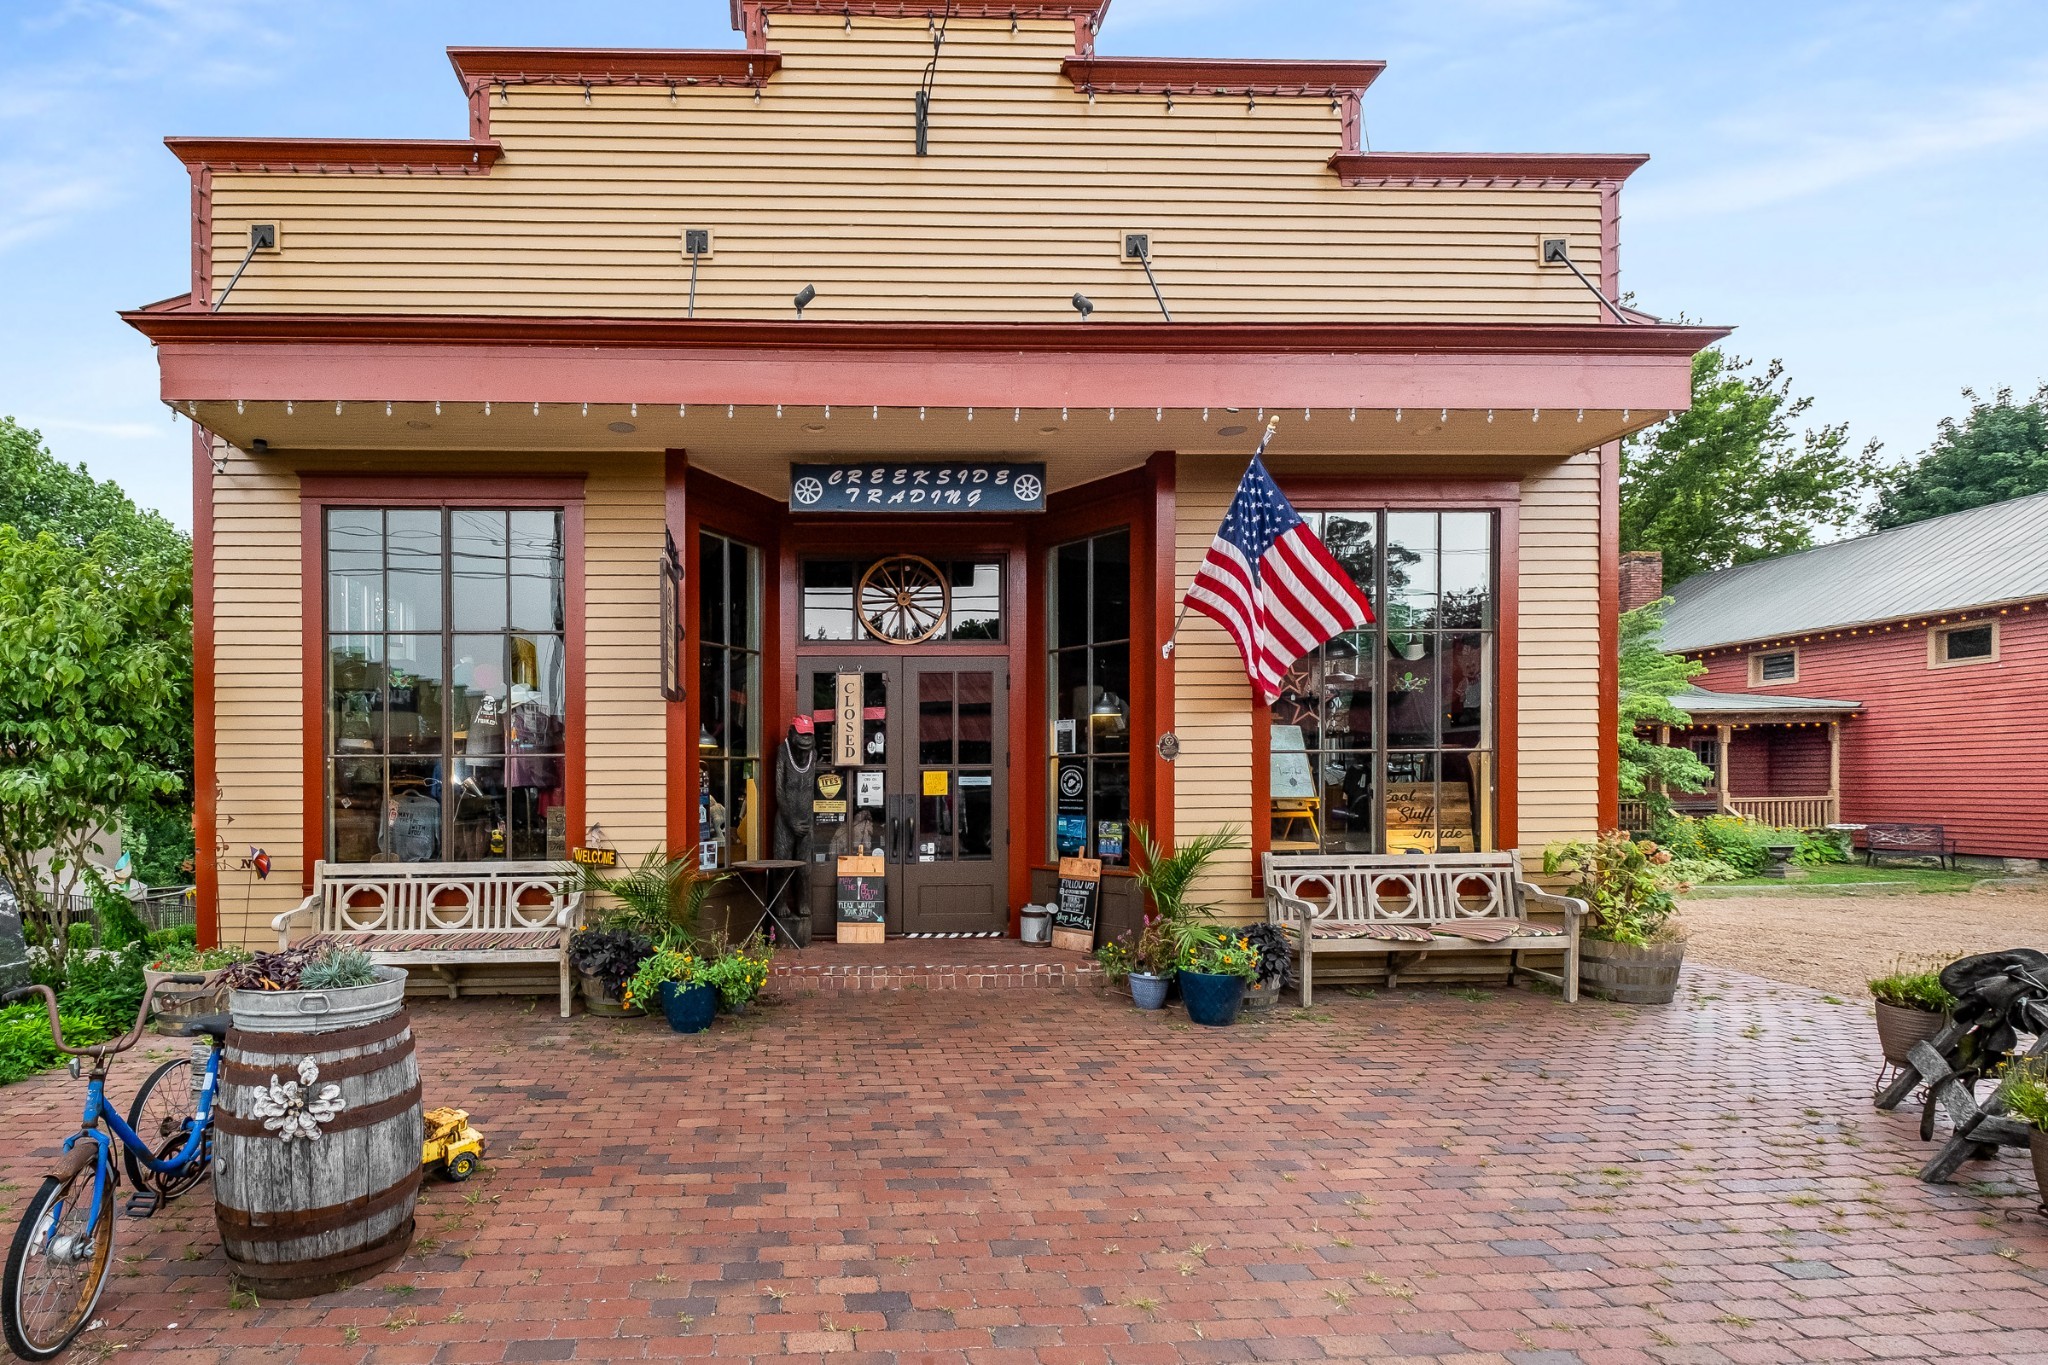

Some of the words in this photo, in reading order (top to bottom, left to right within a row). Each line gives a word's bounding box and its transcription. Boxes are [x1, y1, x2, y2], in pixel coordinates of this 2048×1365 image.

[828, 469, 1010, 485] CREEKSIDE
[845, 487, 982, 507] TRADING
[844, 682, 856, 758] CLOSED
[1397, 806, 1435, 823] Stuff
[1413, 826, 1471, 839] Inide
[241, 859, 252, 869] N
[574, 849, 615, 865] WELCOME
[1062, 879, 1084, 889] FOLLOW
